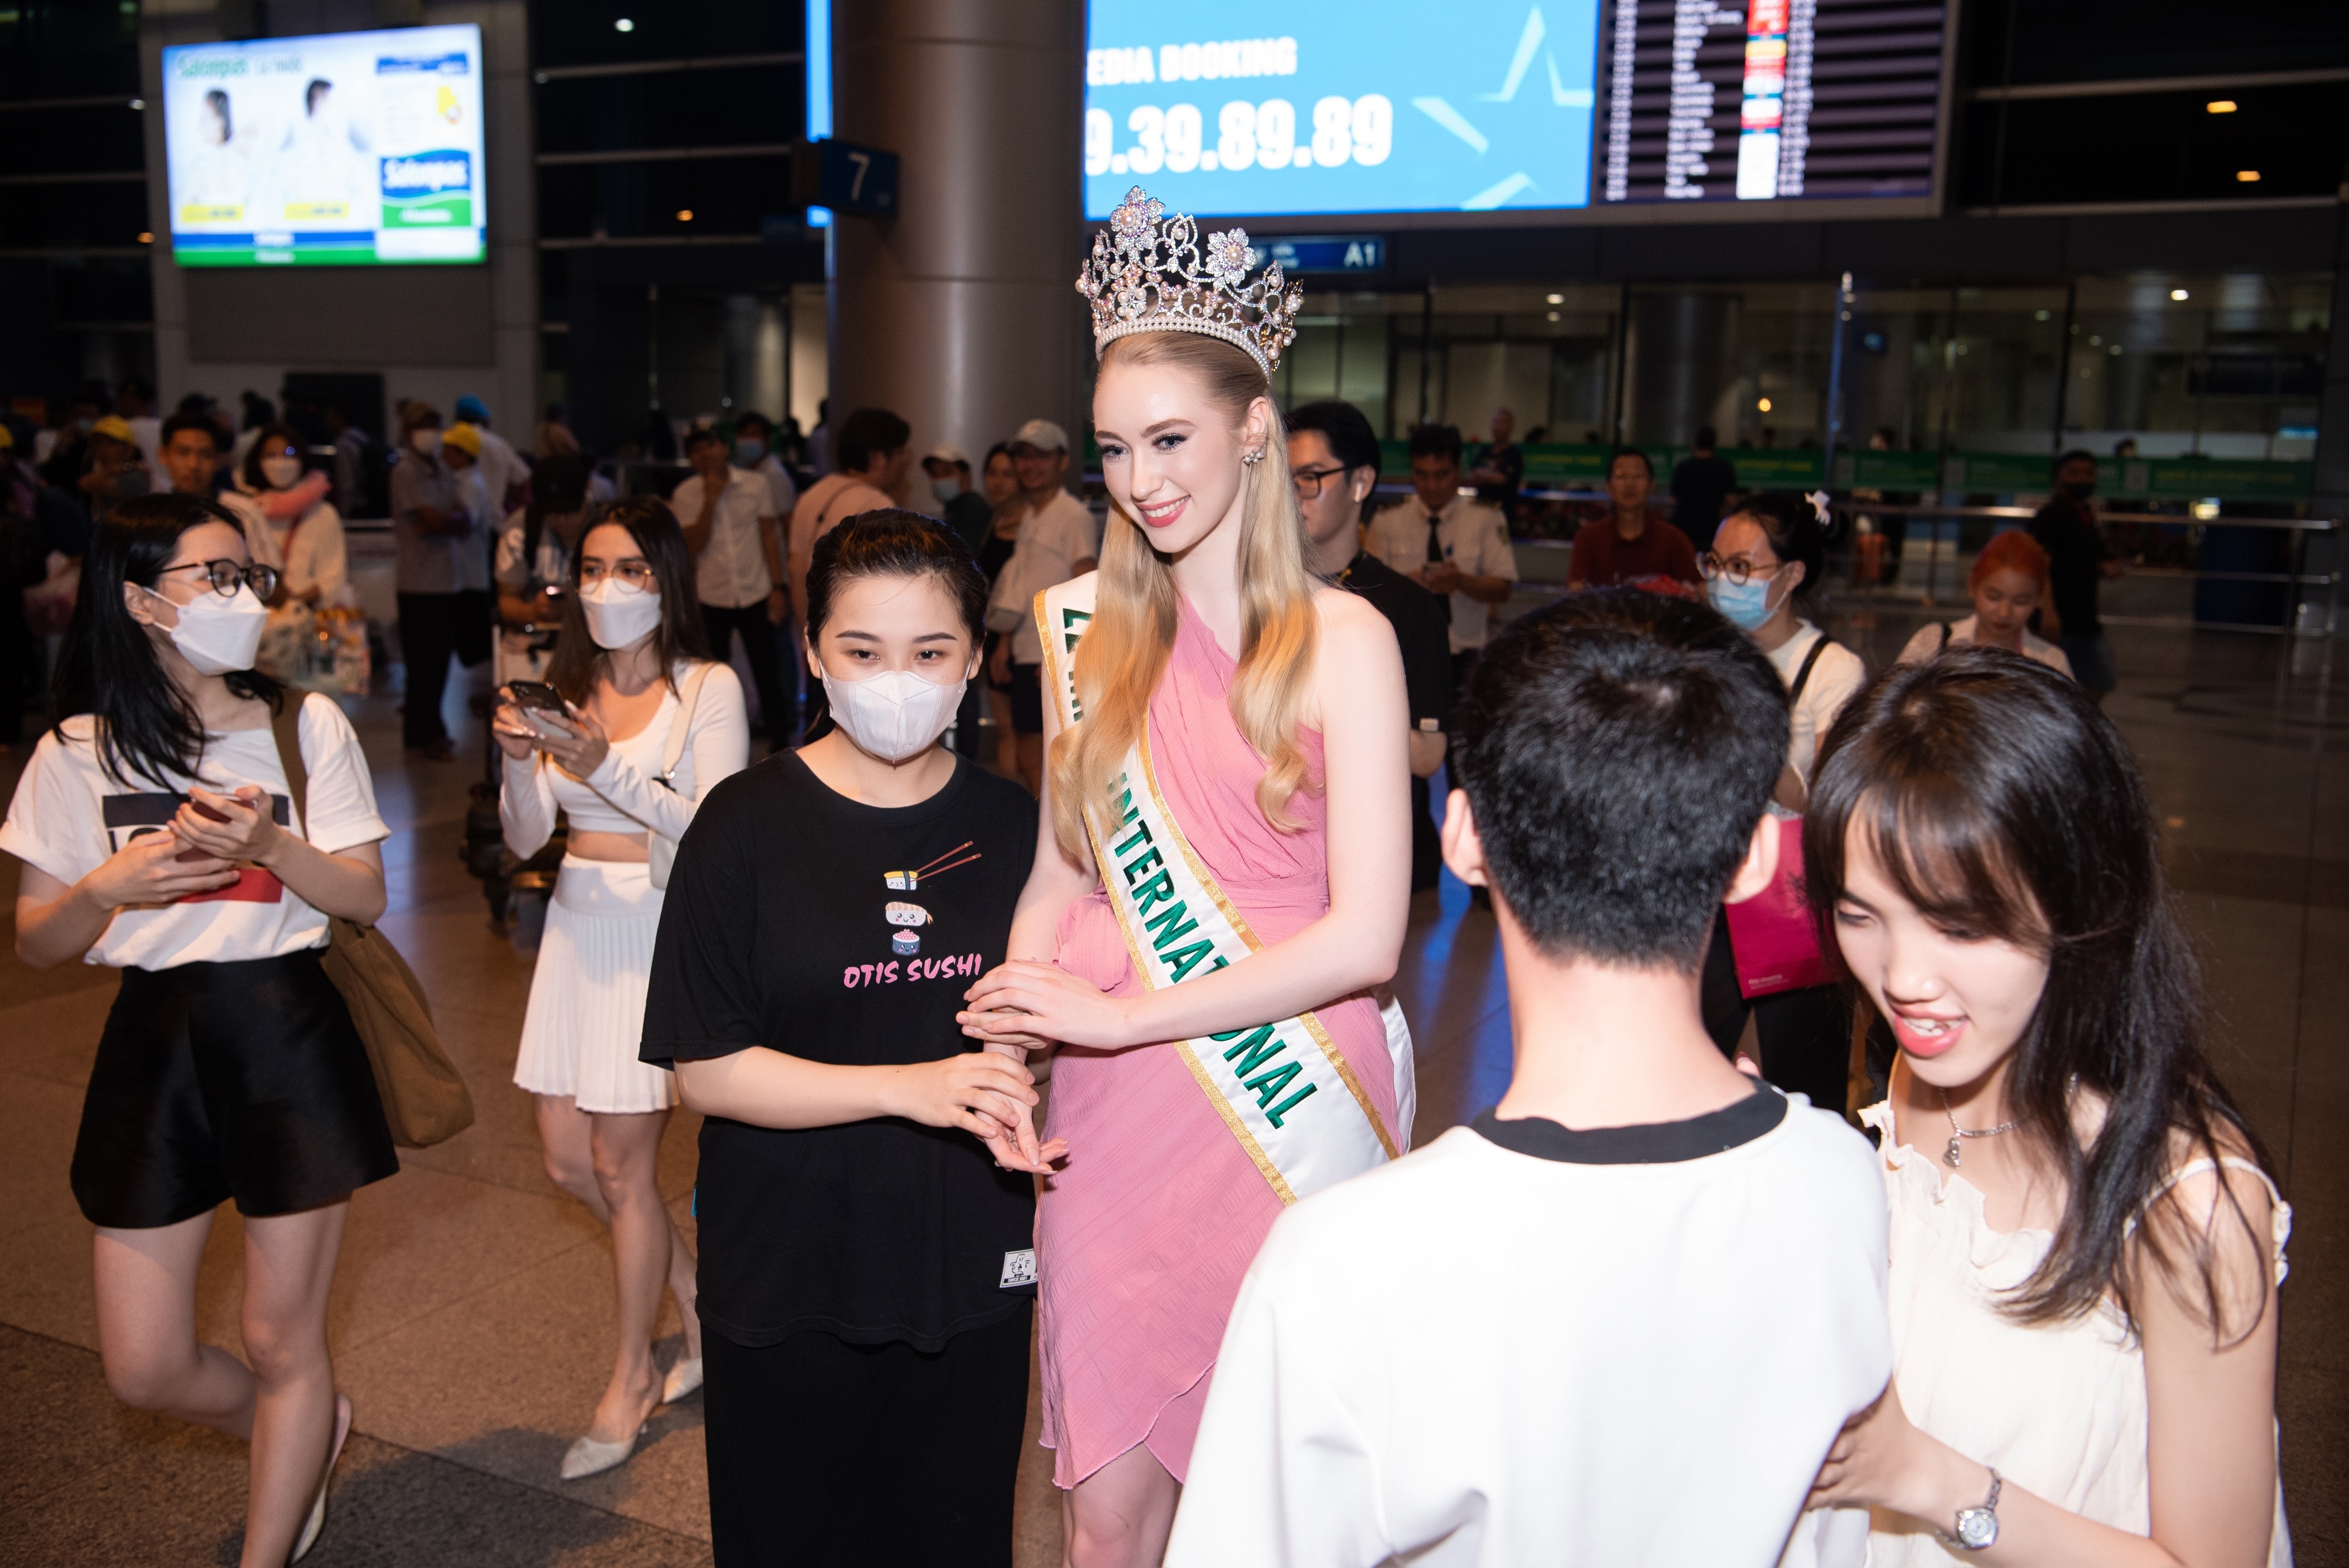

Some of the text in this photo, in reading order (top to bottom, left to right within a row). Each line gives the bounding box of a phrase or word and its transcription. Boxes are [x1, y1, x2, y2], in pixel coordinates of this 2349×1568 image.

[1159, 37, 1298, 83] BOOKING
[847, 151, 871, 201] 7
[1343, 240, 1376, 268] A1
[843, 953, 982, 988] OTIS SUSHI
[1107, 771, 1318, 1130] NTERNANAL
